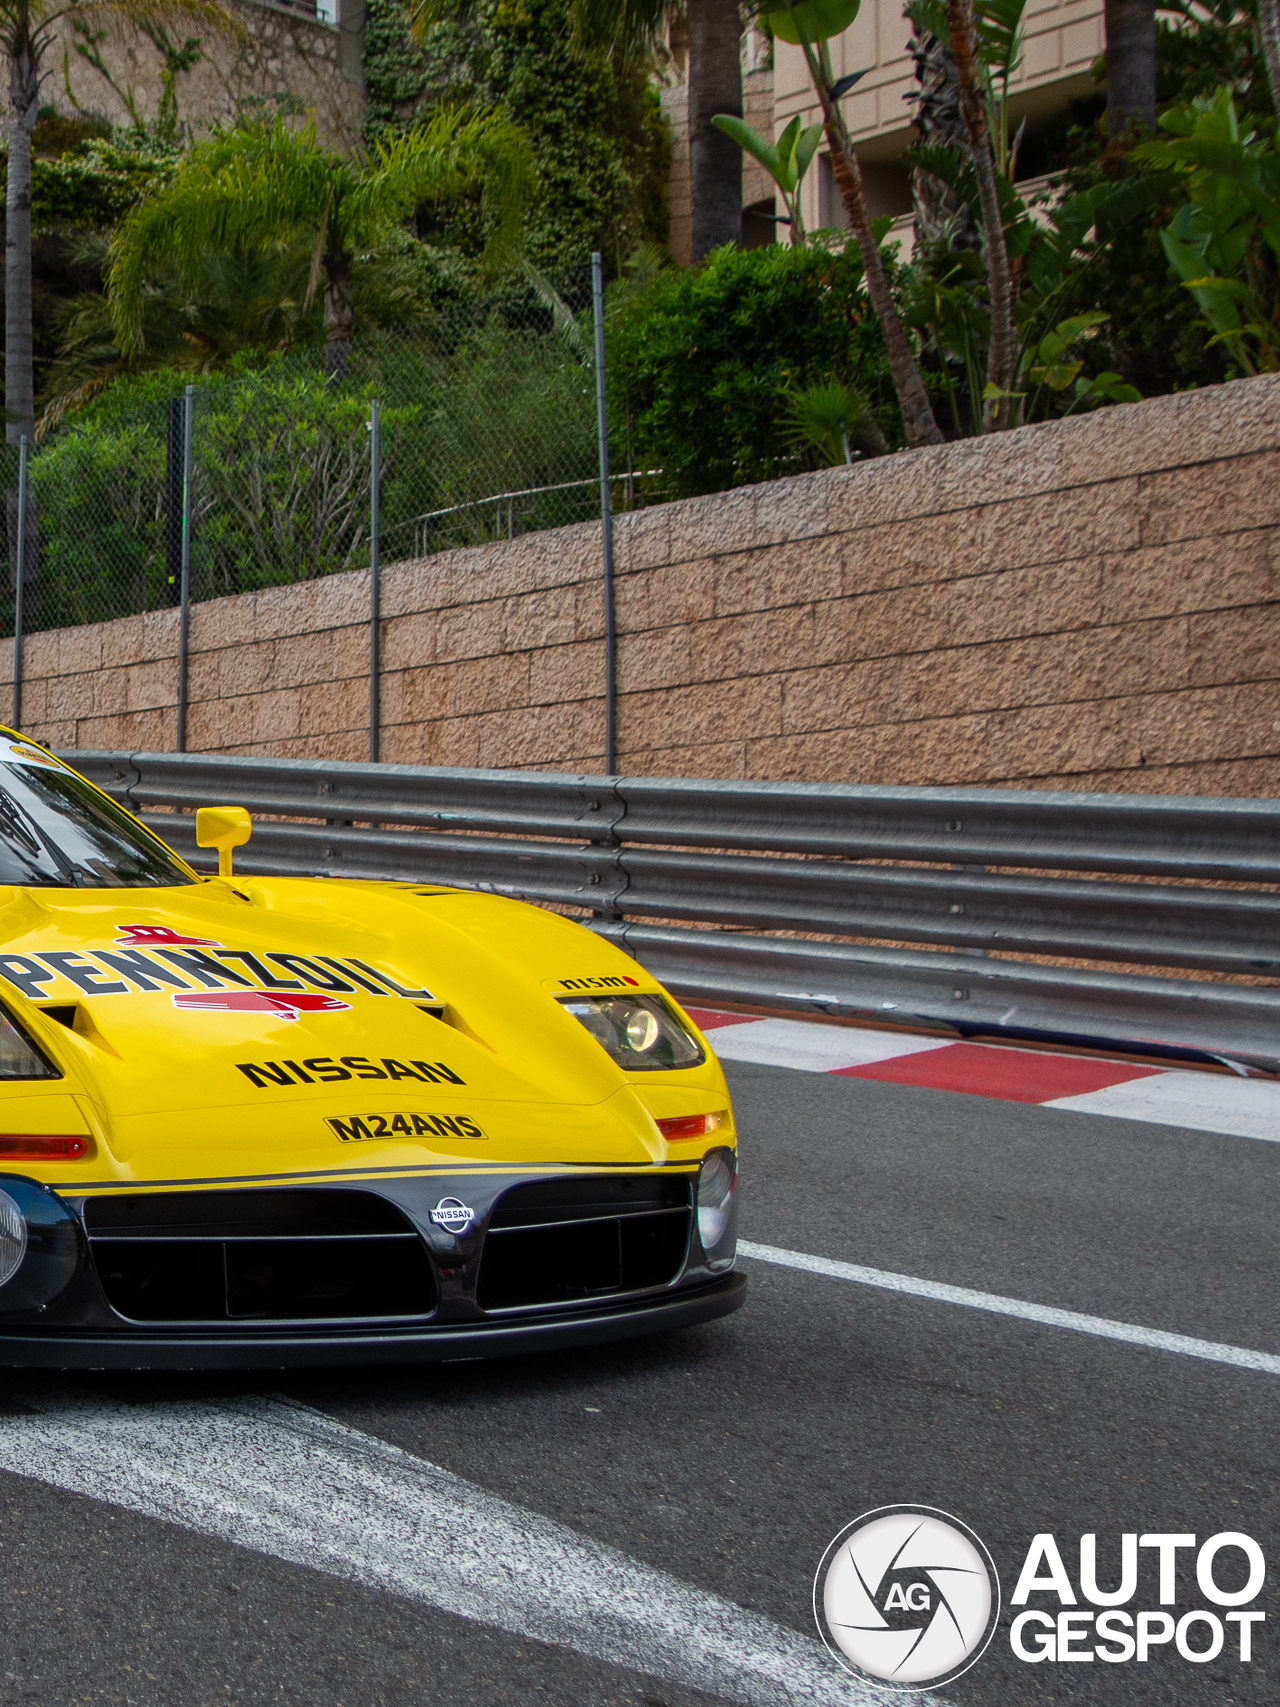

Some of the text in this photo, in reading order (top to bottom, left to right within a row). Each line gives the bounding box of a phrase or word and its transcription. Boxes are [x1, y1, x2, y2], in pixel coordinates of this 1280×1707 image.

[234, 1056, 468, 1089] NISSAN
[326, 1114, 483, 1141] M24ANS
[437, 1210, 471, 1220] NISSAN
